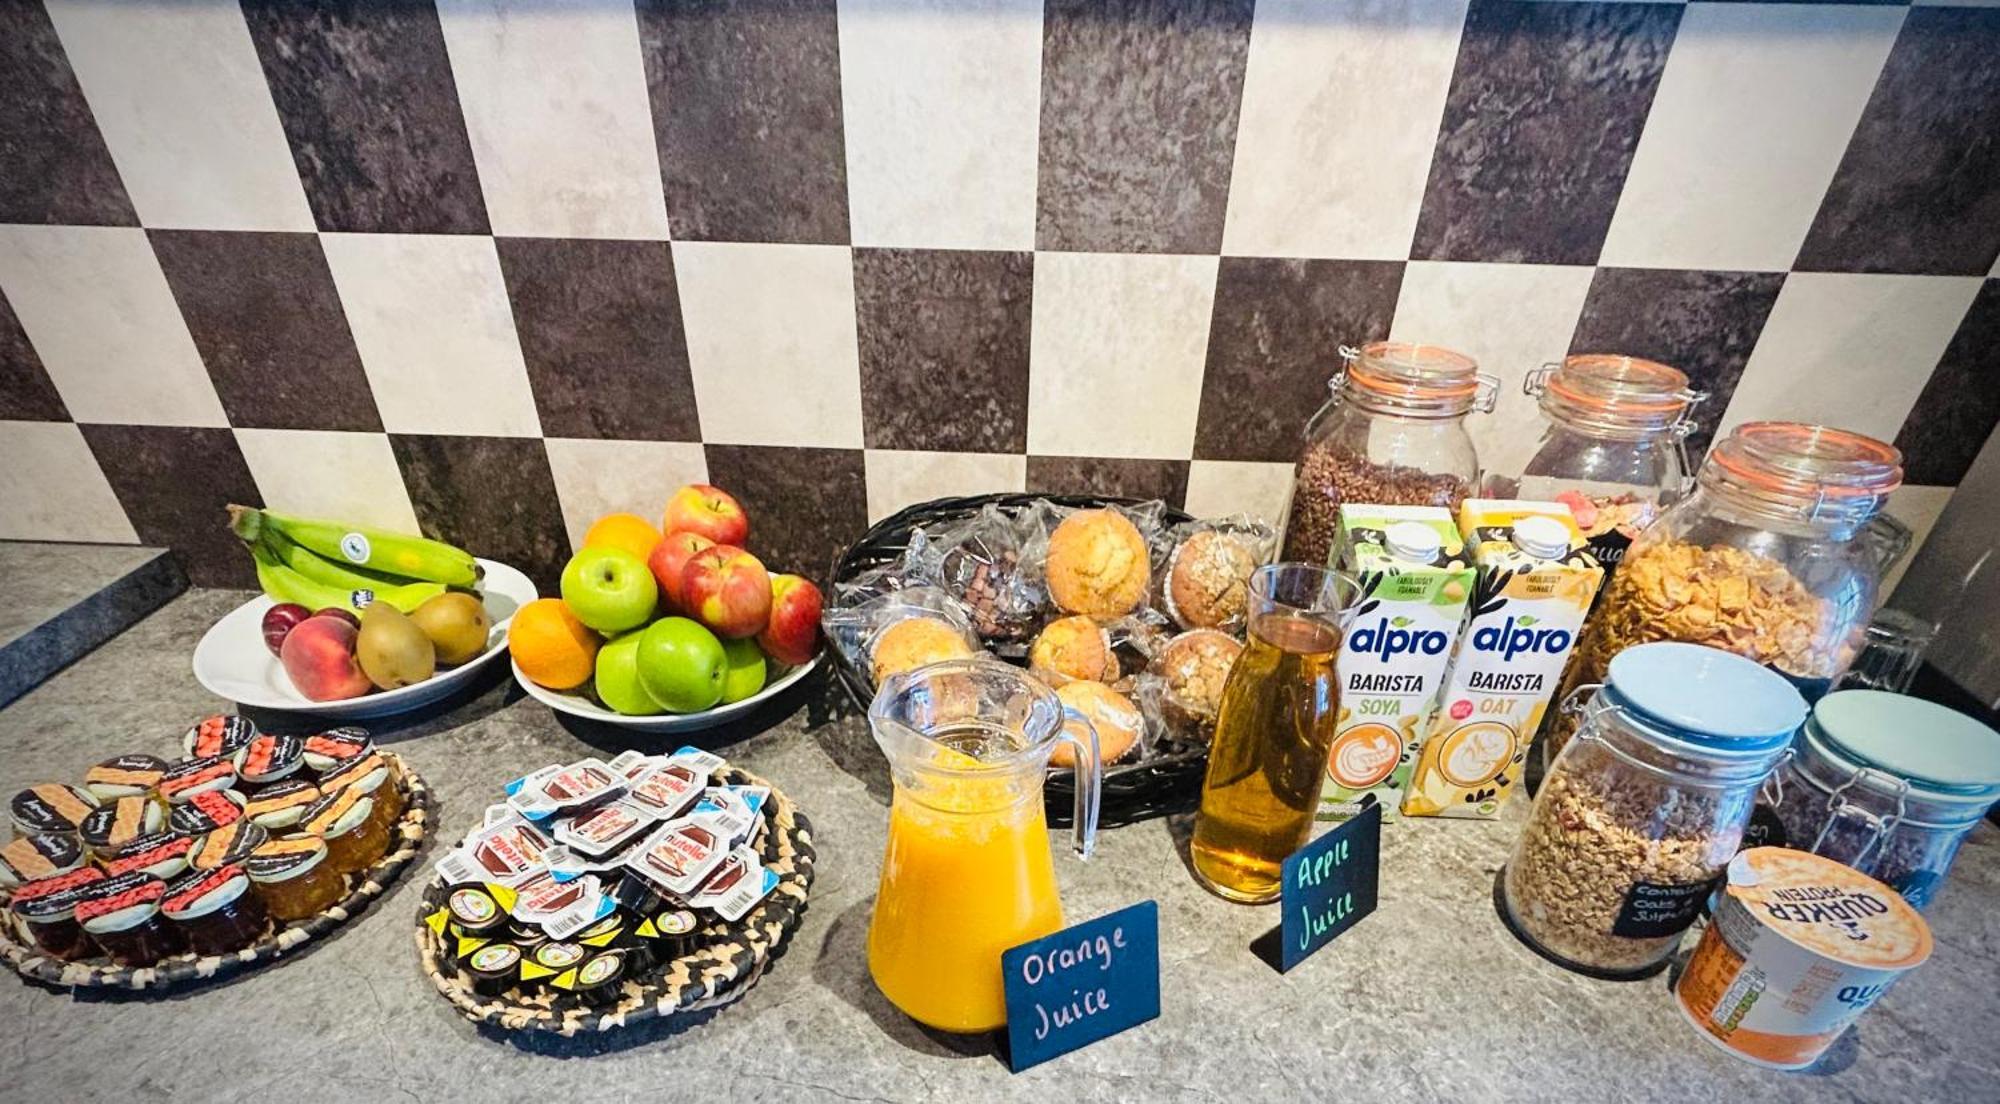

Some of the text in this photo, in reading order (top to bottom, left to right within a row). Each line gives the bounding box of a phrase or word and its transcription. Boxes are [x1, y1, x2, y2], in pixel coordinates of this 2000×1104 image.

[1349, 617, 1448, 663] alpro
[1473, 616, 1571, 662] alpro
[1348, 673, 1424, 693] BARISTA
[1468, 671, 1544, 691] BARISTA
[1358, 699, 1401, 716] SOYA
[1480, 698, 1517, 714] OAT
[489, 834, 530, 873] nutella
[663, 834, 707, 862] nutella
[1298, 839, 1349, 889] Apple
[1760, 892, 1889, 924] QUAKER
[1773, 885, 1846, 901] PROTEIN
[1300, 892, 1354, 951] Juice
[1023, 926, 1128, 985] Orange
[1035, 988, 1110, 1040] Juice
